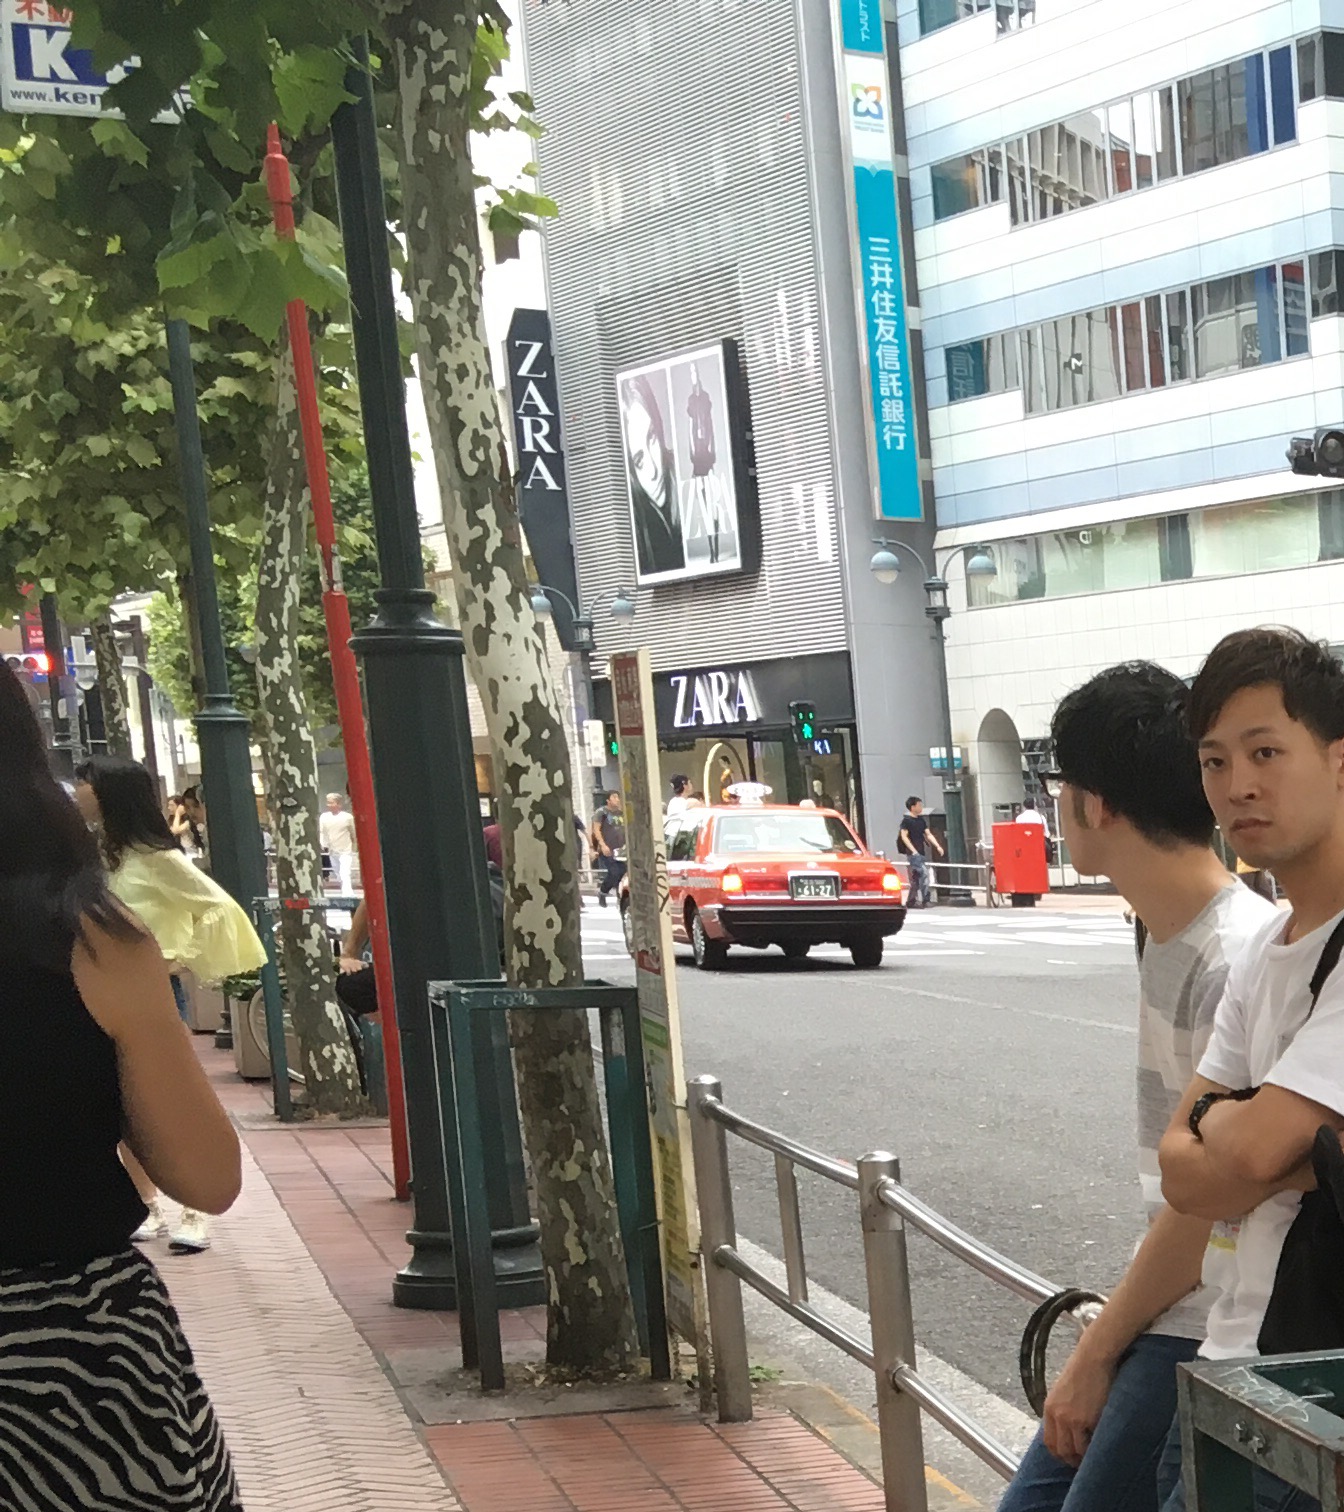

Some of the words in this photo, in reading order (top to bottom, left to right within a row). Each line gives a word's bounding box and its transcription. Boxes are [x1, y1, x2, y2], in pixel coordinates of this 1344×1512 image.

[515, 340, 562, 491] ZARA
[868, 236, 907, 451] 三井住友信託銀行
[670, 671, 758, 728] ZARA
